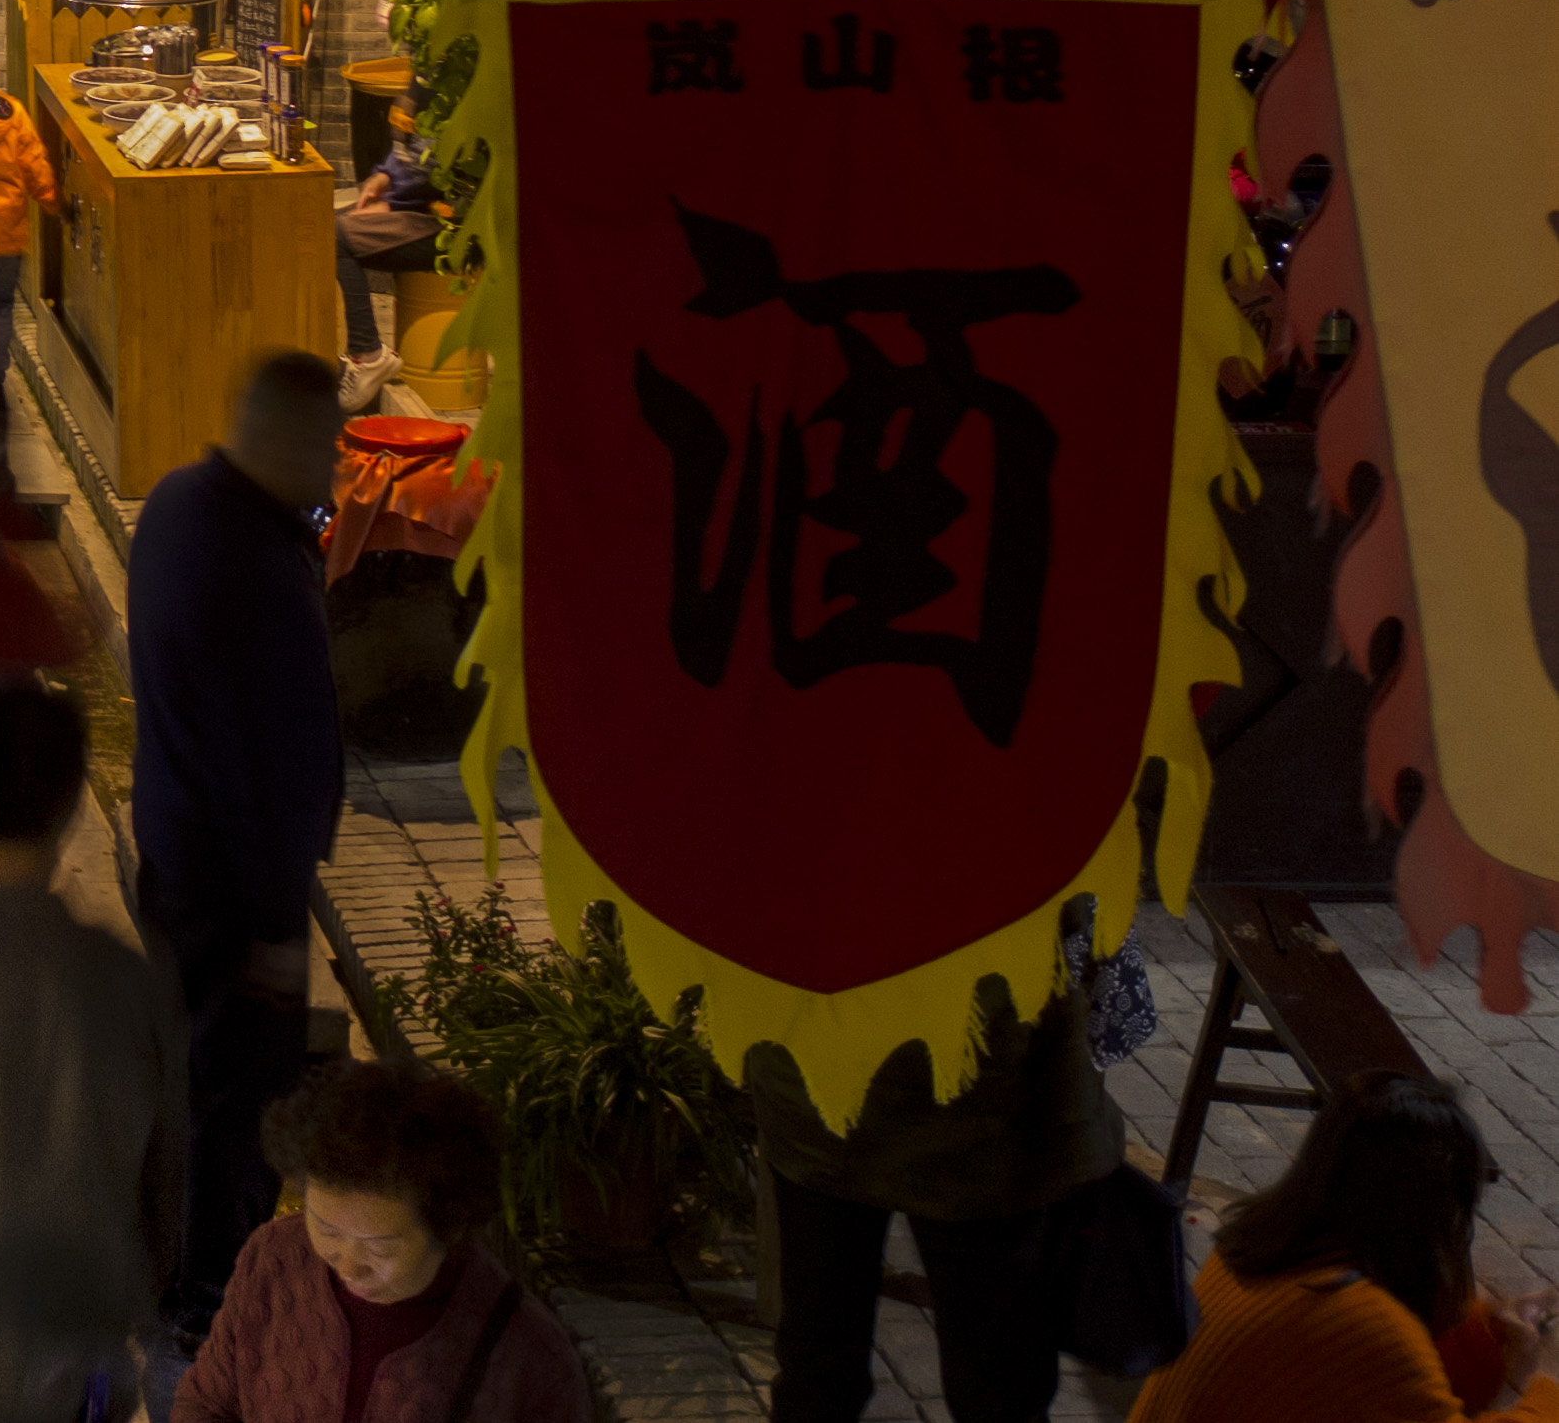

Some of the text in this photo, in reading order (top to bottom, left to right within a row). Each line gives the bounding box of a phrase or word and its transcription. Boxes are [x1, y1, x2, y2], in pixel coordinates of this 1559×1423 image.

[646, 14, 1064, 104] 岚山根
[633, 198, 1082, 748] 酒
